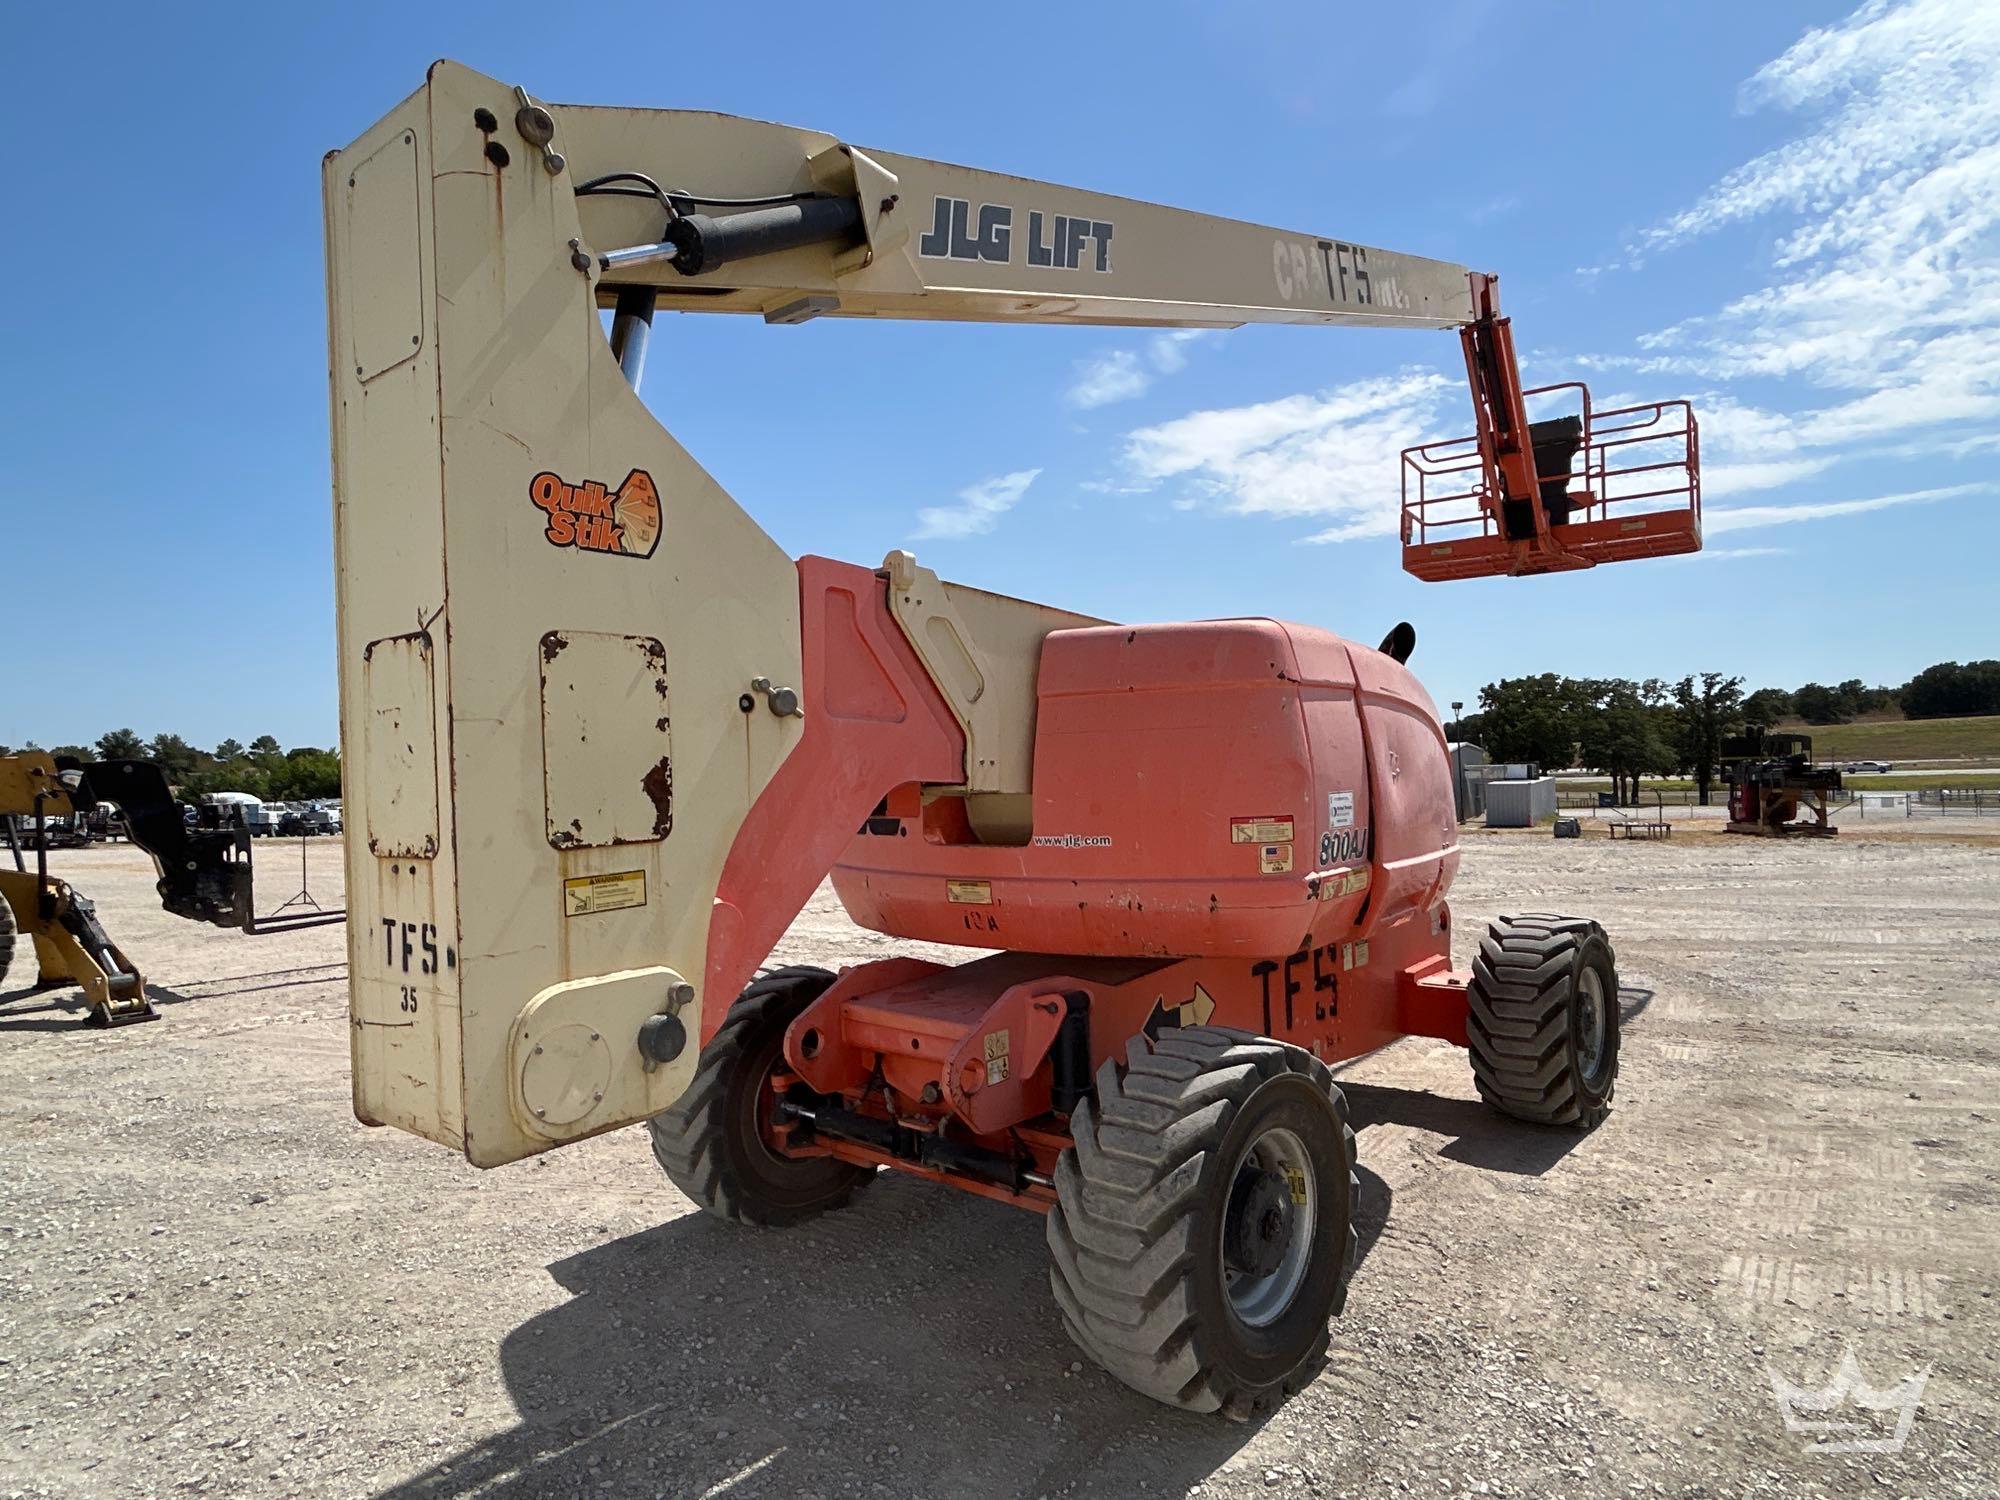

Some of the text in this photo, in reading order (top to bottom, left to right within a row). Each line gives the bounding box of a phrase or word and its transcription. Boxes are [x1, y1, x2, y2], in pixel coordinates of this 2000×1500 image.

[919, 194, 1113, 273] JLG LIFT
[1317, 240, 1372, 304] TFS
[531, 473, 617, 519] Quik
[548, 511, 624, 552] Stik
[1033, 834, 1112, 848] www.jlg.com
[1320, 828, 1368, 866] 800AJ
[383, 918, 438, 974] TFS
[401, 986, 418, 1013] 35
[1252, 943, 1338, 1036] TFS
